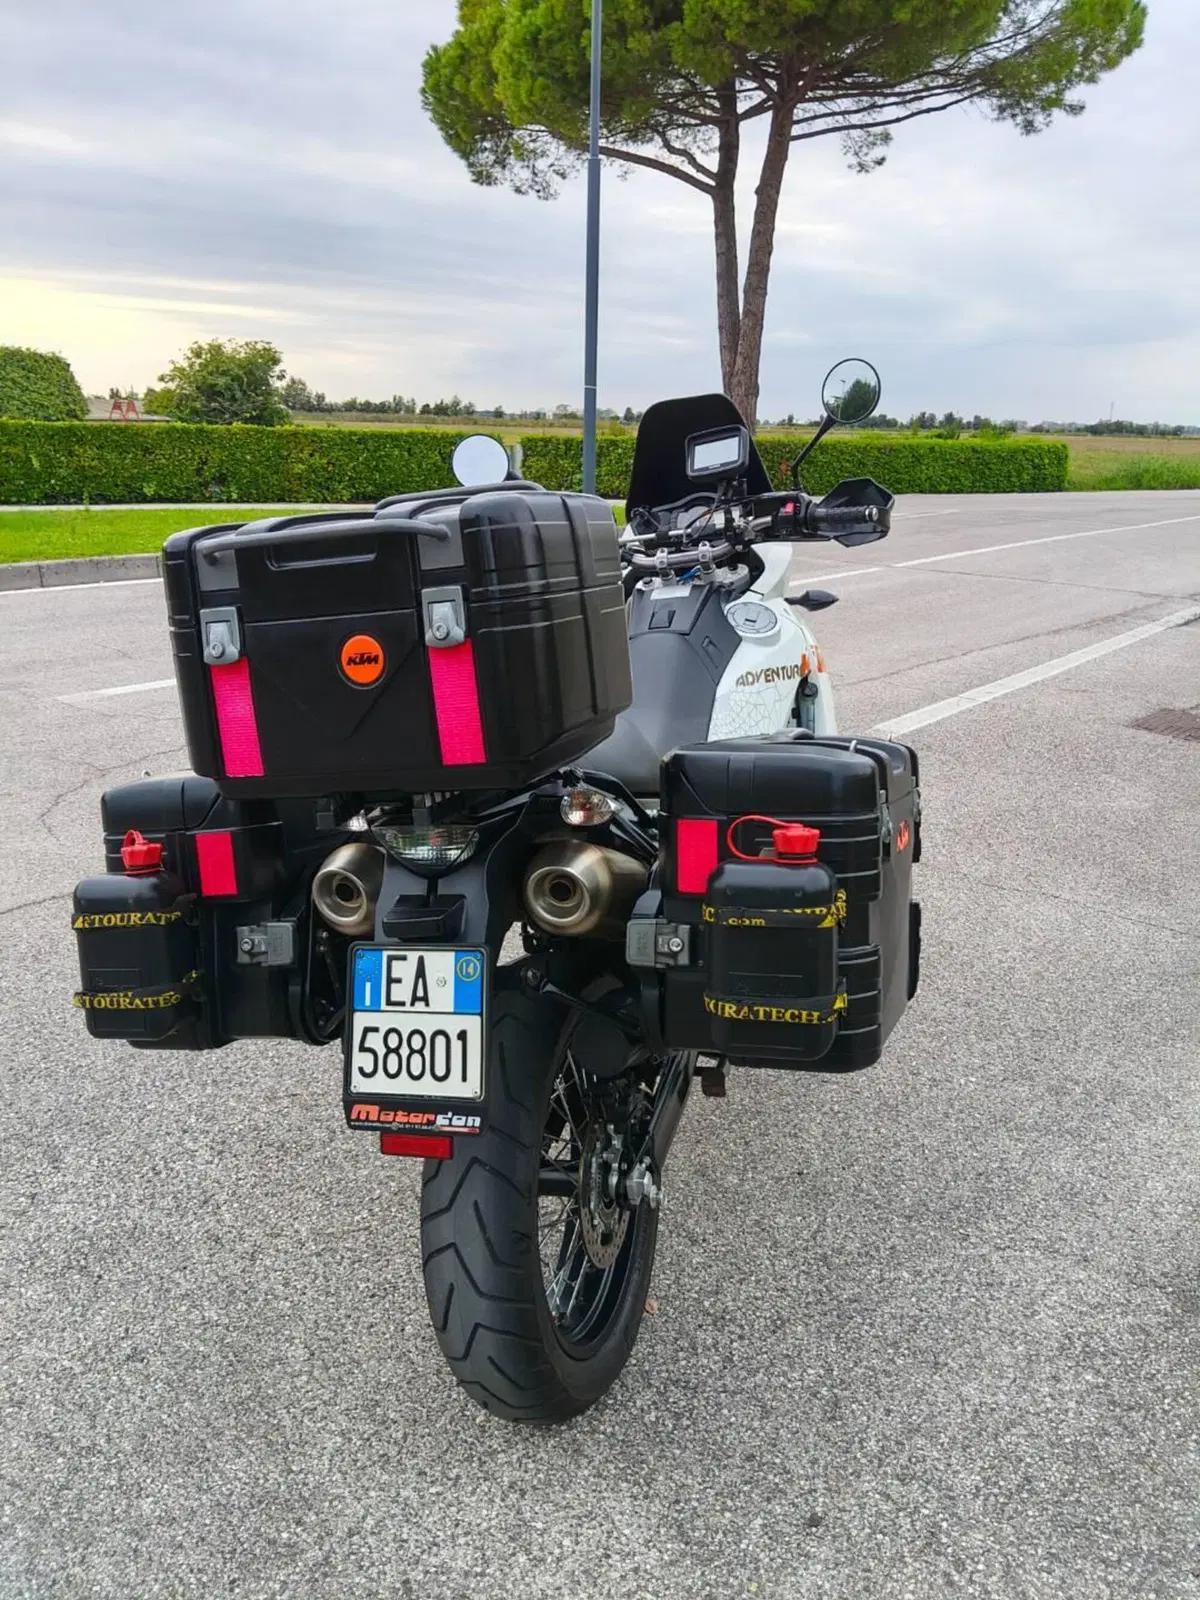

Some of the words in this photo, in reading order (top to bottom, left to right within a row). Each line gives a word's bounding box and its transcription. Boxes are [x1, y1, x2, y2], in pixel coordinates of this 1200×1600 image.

[346, 652, 380, 666] KTM
[385, 954, 430, 1007] EA
[357, 1026, 468, 1083] 58801
